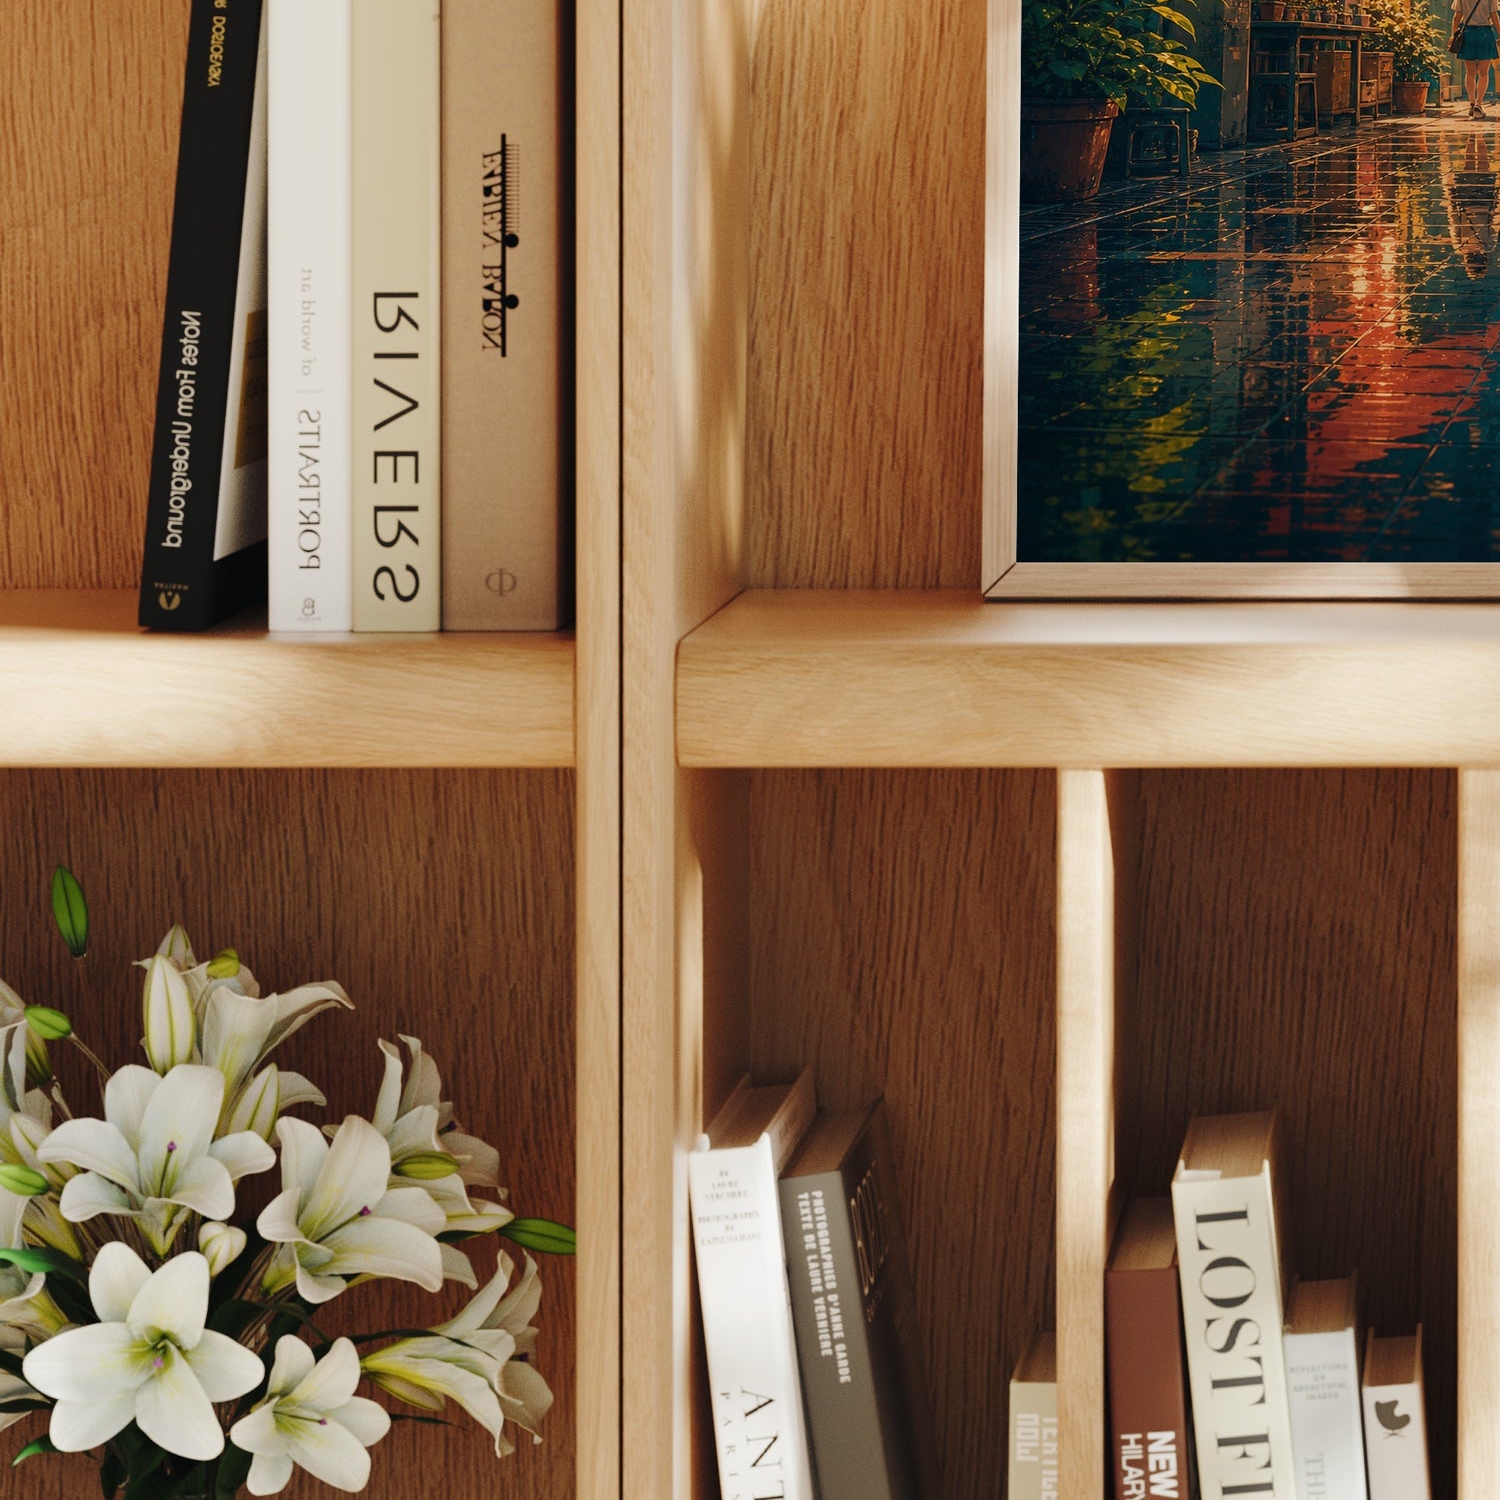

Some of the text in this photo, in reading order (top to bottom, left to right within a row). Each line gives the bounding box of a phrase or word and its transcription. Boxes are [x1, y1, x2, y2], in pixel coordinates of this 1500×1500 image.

[797, 1192, 814, 1230] TEXTE
[803, 1234, 817, 1250] DE
[806, 1254, 824, 1294] LAURE
[811, 1189, 851, 1384] PHOTOGRAPHIES D'ANNE GARDE
[1194, 1204, 1266, 1405] LOST
[1016, 1412, 1040, 1462] NOW
[1147, 1430, 1180, 1498] NEW
